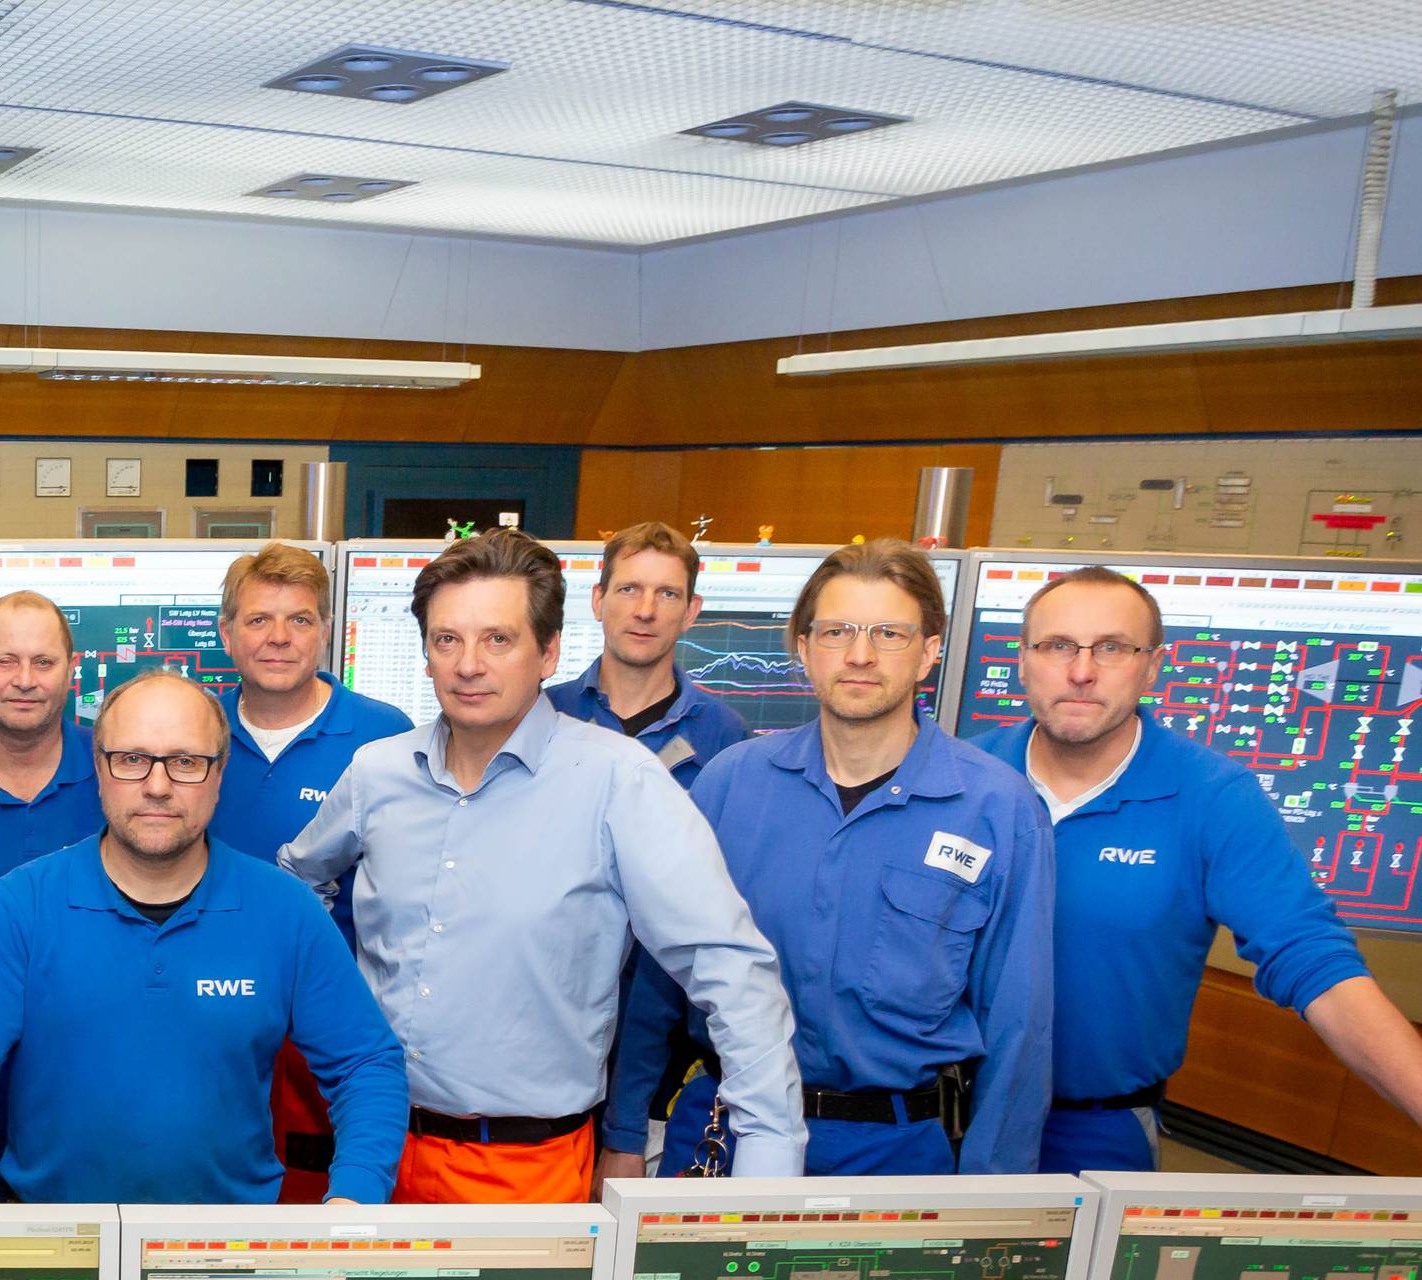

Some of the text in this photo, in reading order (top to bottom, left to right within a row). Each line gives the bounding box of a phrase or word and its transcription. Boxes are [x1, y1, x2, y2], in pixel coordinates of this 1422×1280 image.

[299, 787, 328, 802] RW
[938, 845, 977, 869] RWE
[1099, 847, 1157, 865] RWE
[196, 979, 256, 997] RWE
